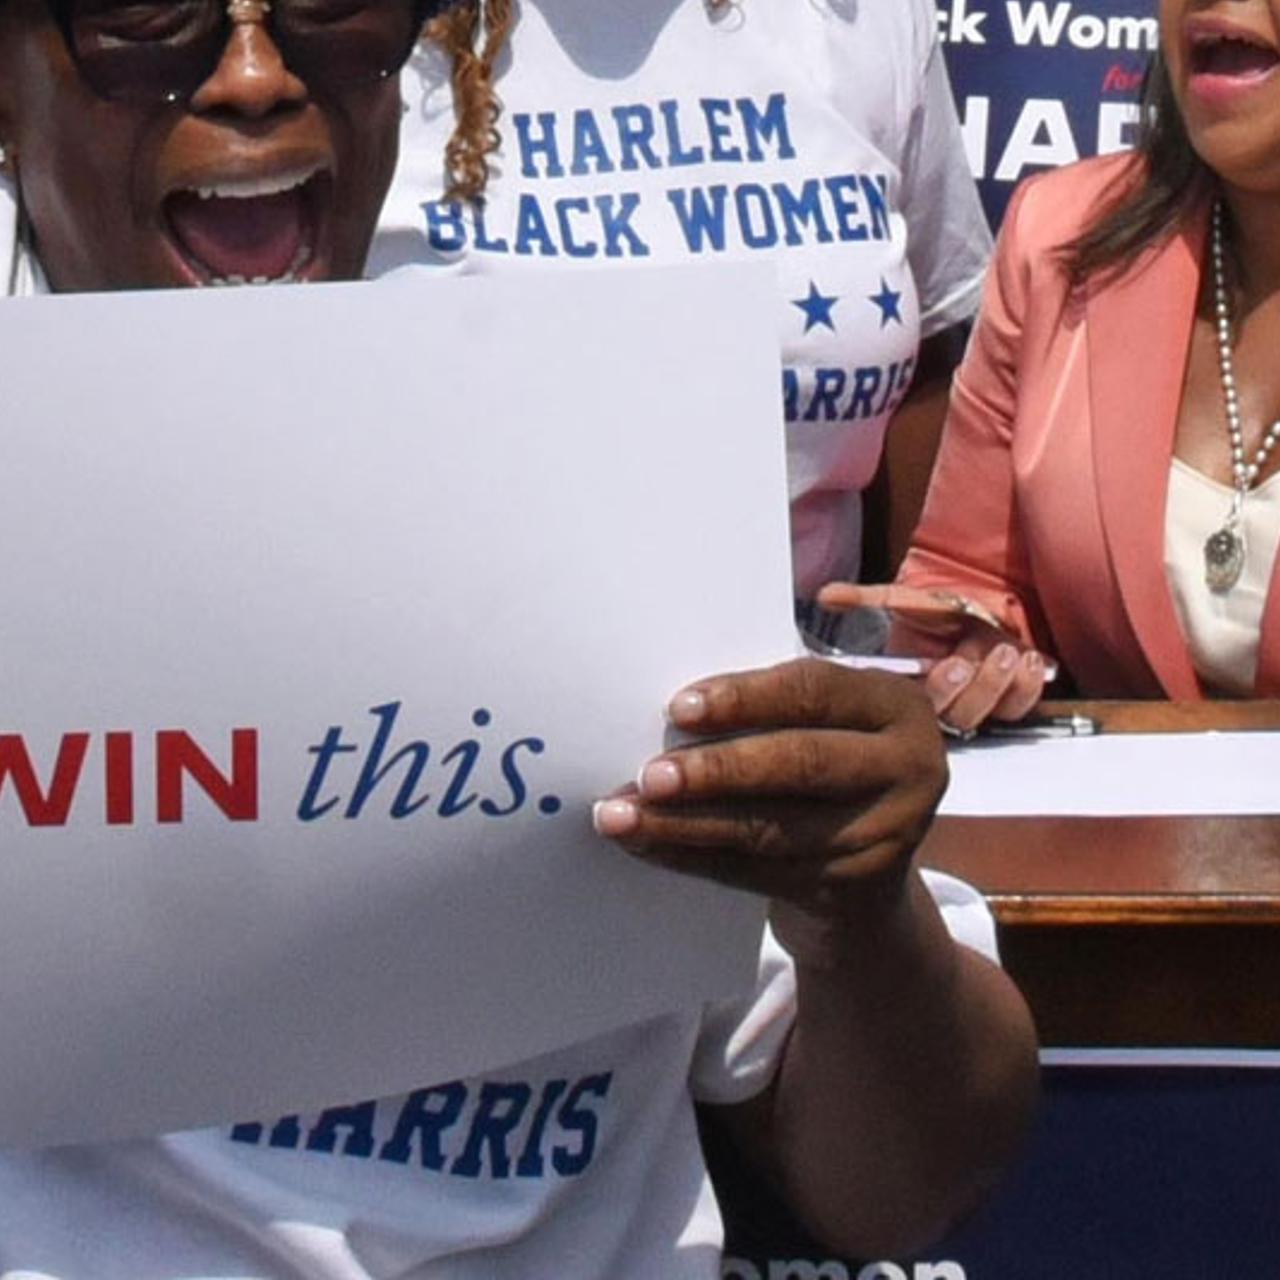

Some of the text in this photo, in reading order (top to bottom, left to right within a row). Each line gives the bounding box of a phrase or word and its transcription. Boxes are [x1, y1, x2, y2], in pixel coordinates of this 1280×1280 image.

[1006, 0, 1159, 51] Wom
[512, 93, 797, 178] HARLEM
[420, 174, 893, 258] BLACK WOMEN
[296, 701, 562, 823] this.
